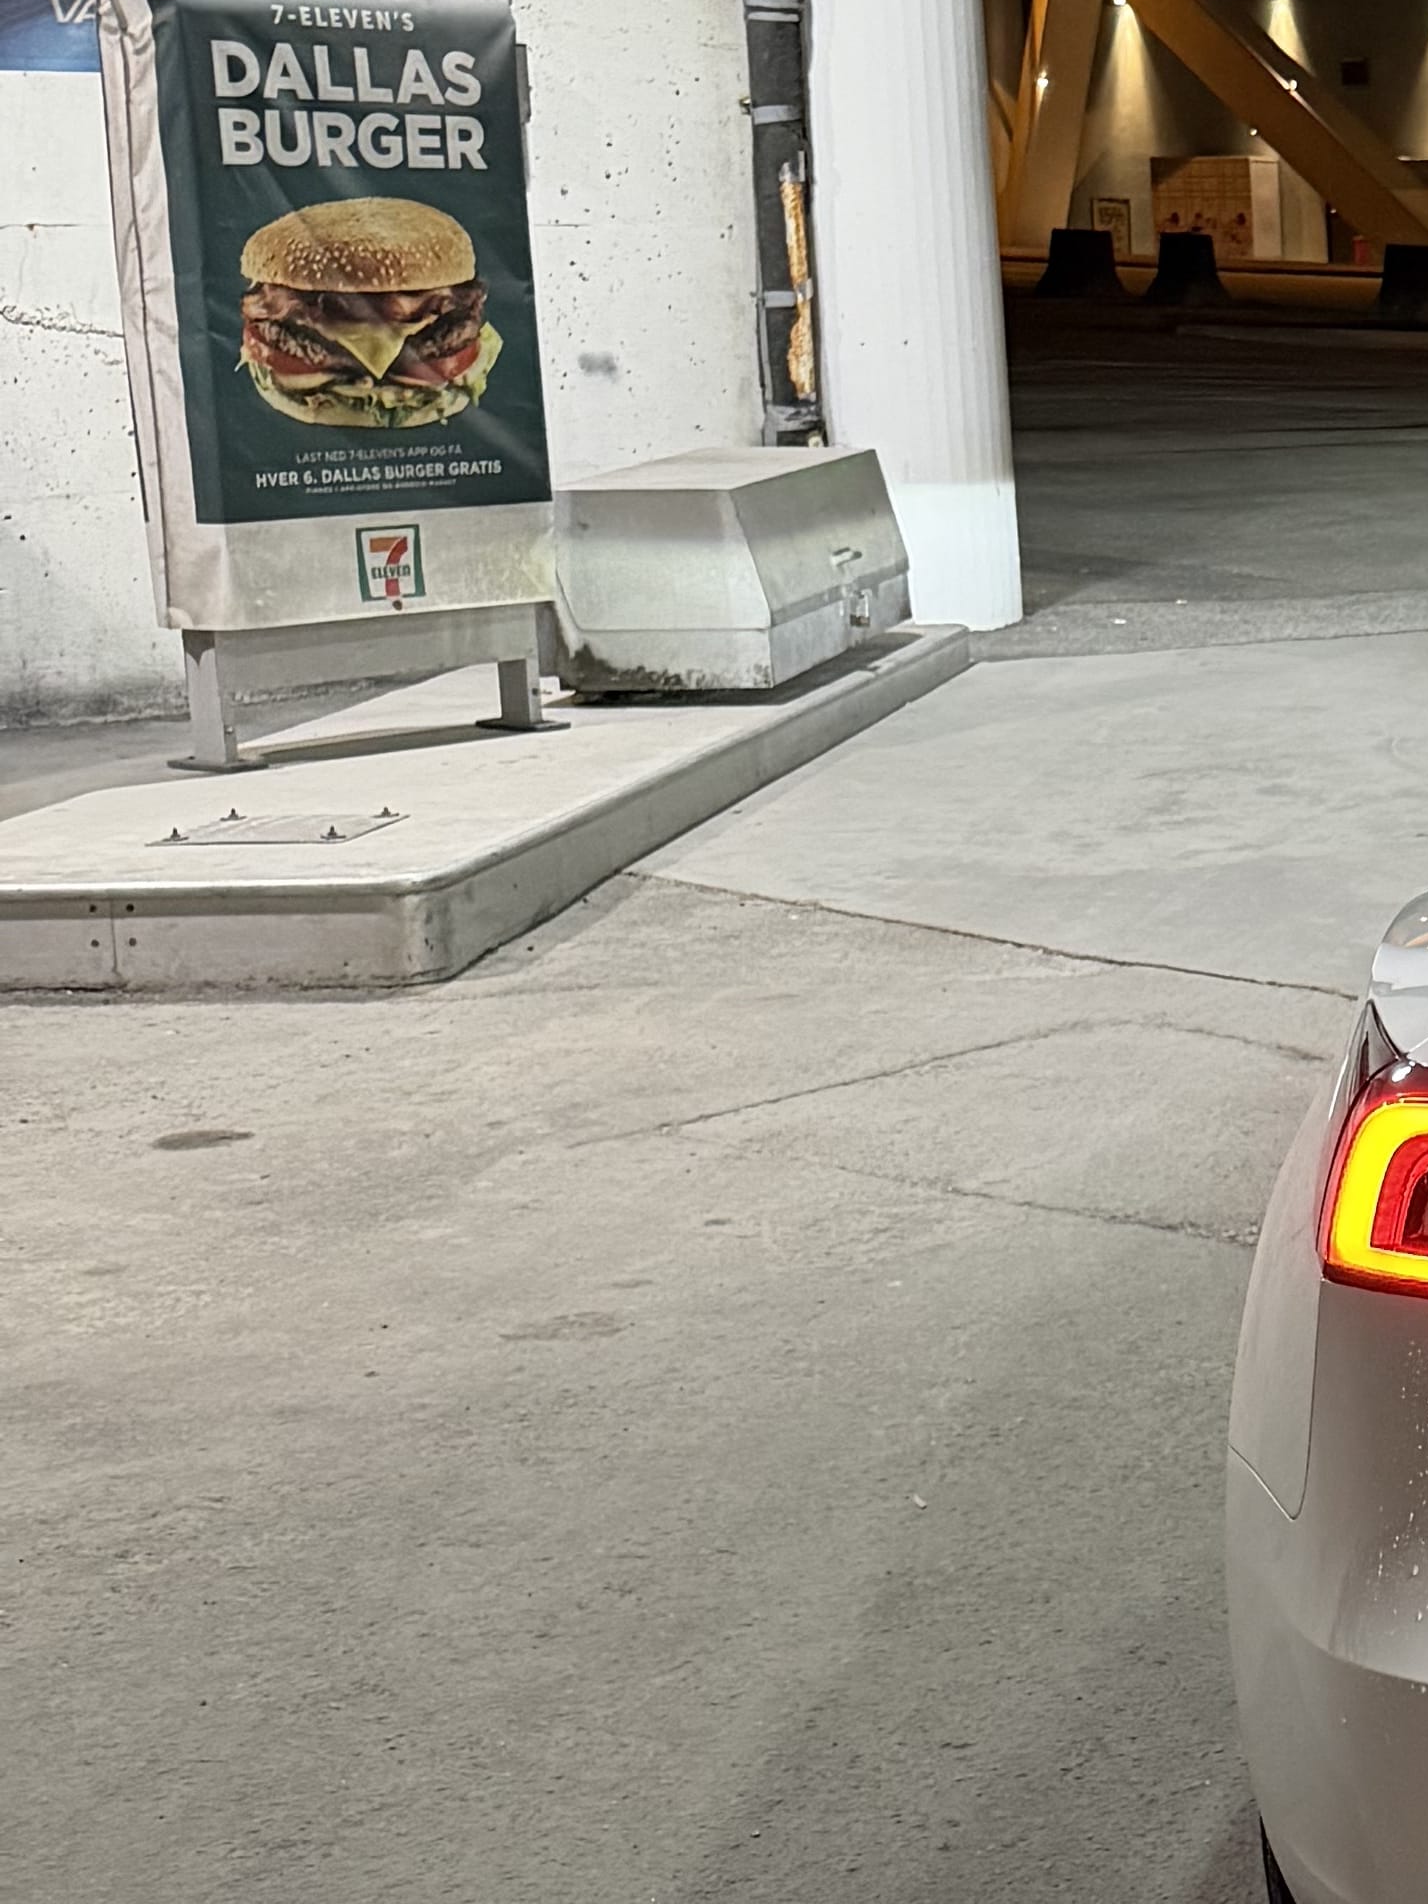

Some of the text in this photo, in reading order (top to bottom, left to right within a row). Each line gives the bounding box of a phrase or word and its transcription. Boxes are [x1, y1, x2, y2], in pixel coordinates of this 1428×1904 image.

[270, 4, 415, 32] 7-ELEVEN'S
[210, 39, 482, 107] DALLAS
[217, 108, 488, 170] BURGER
[256, 471, 299, 488] HVER
[322, 466, 381, 484] DALLAS
[385, 463, 444, 480] BURGER
[449, 459, 502, 476] GRATIS
